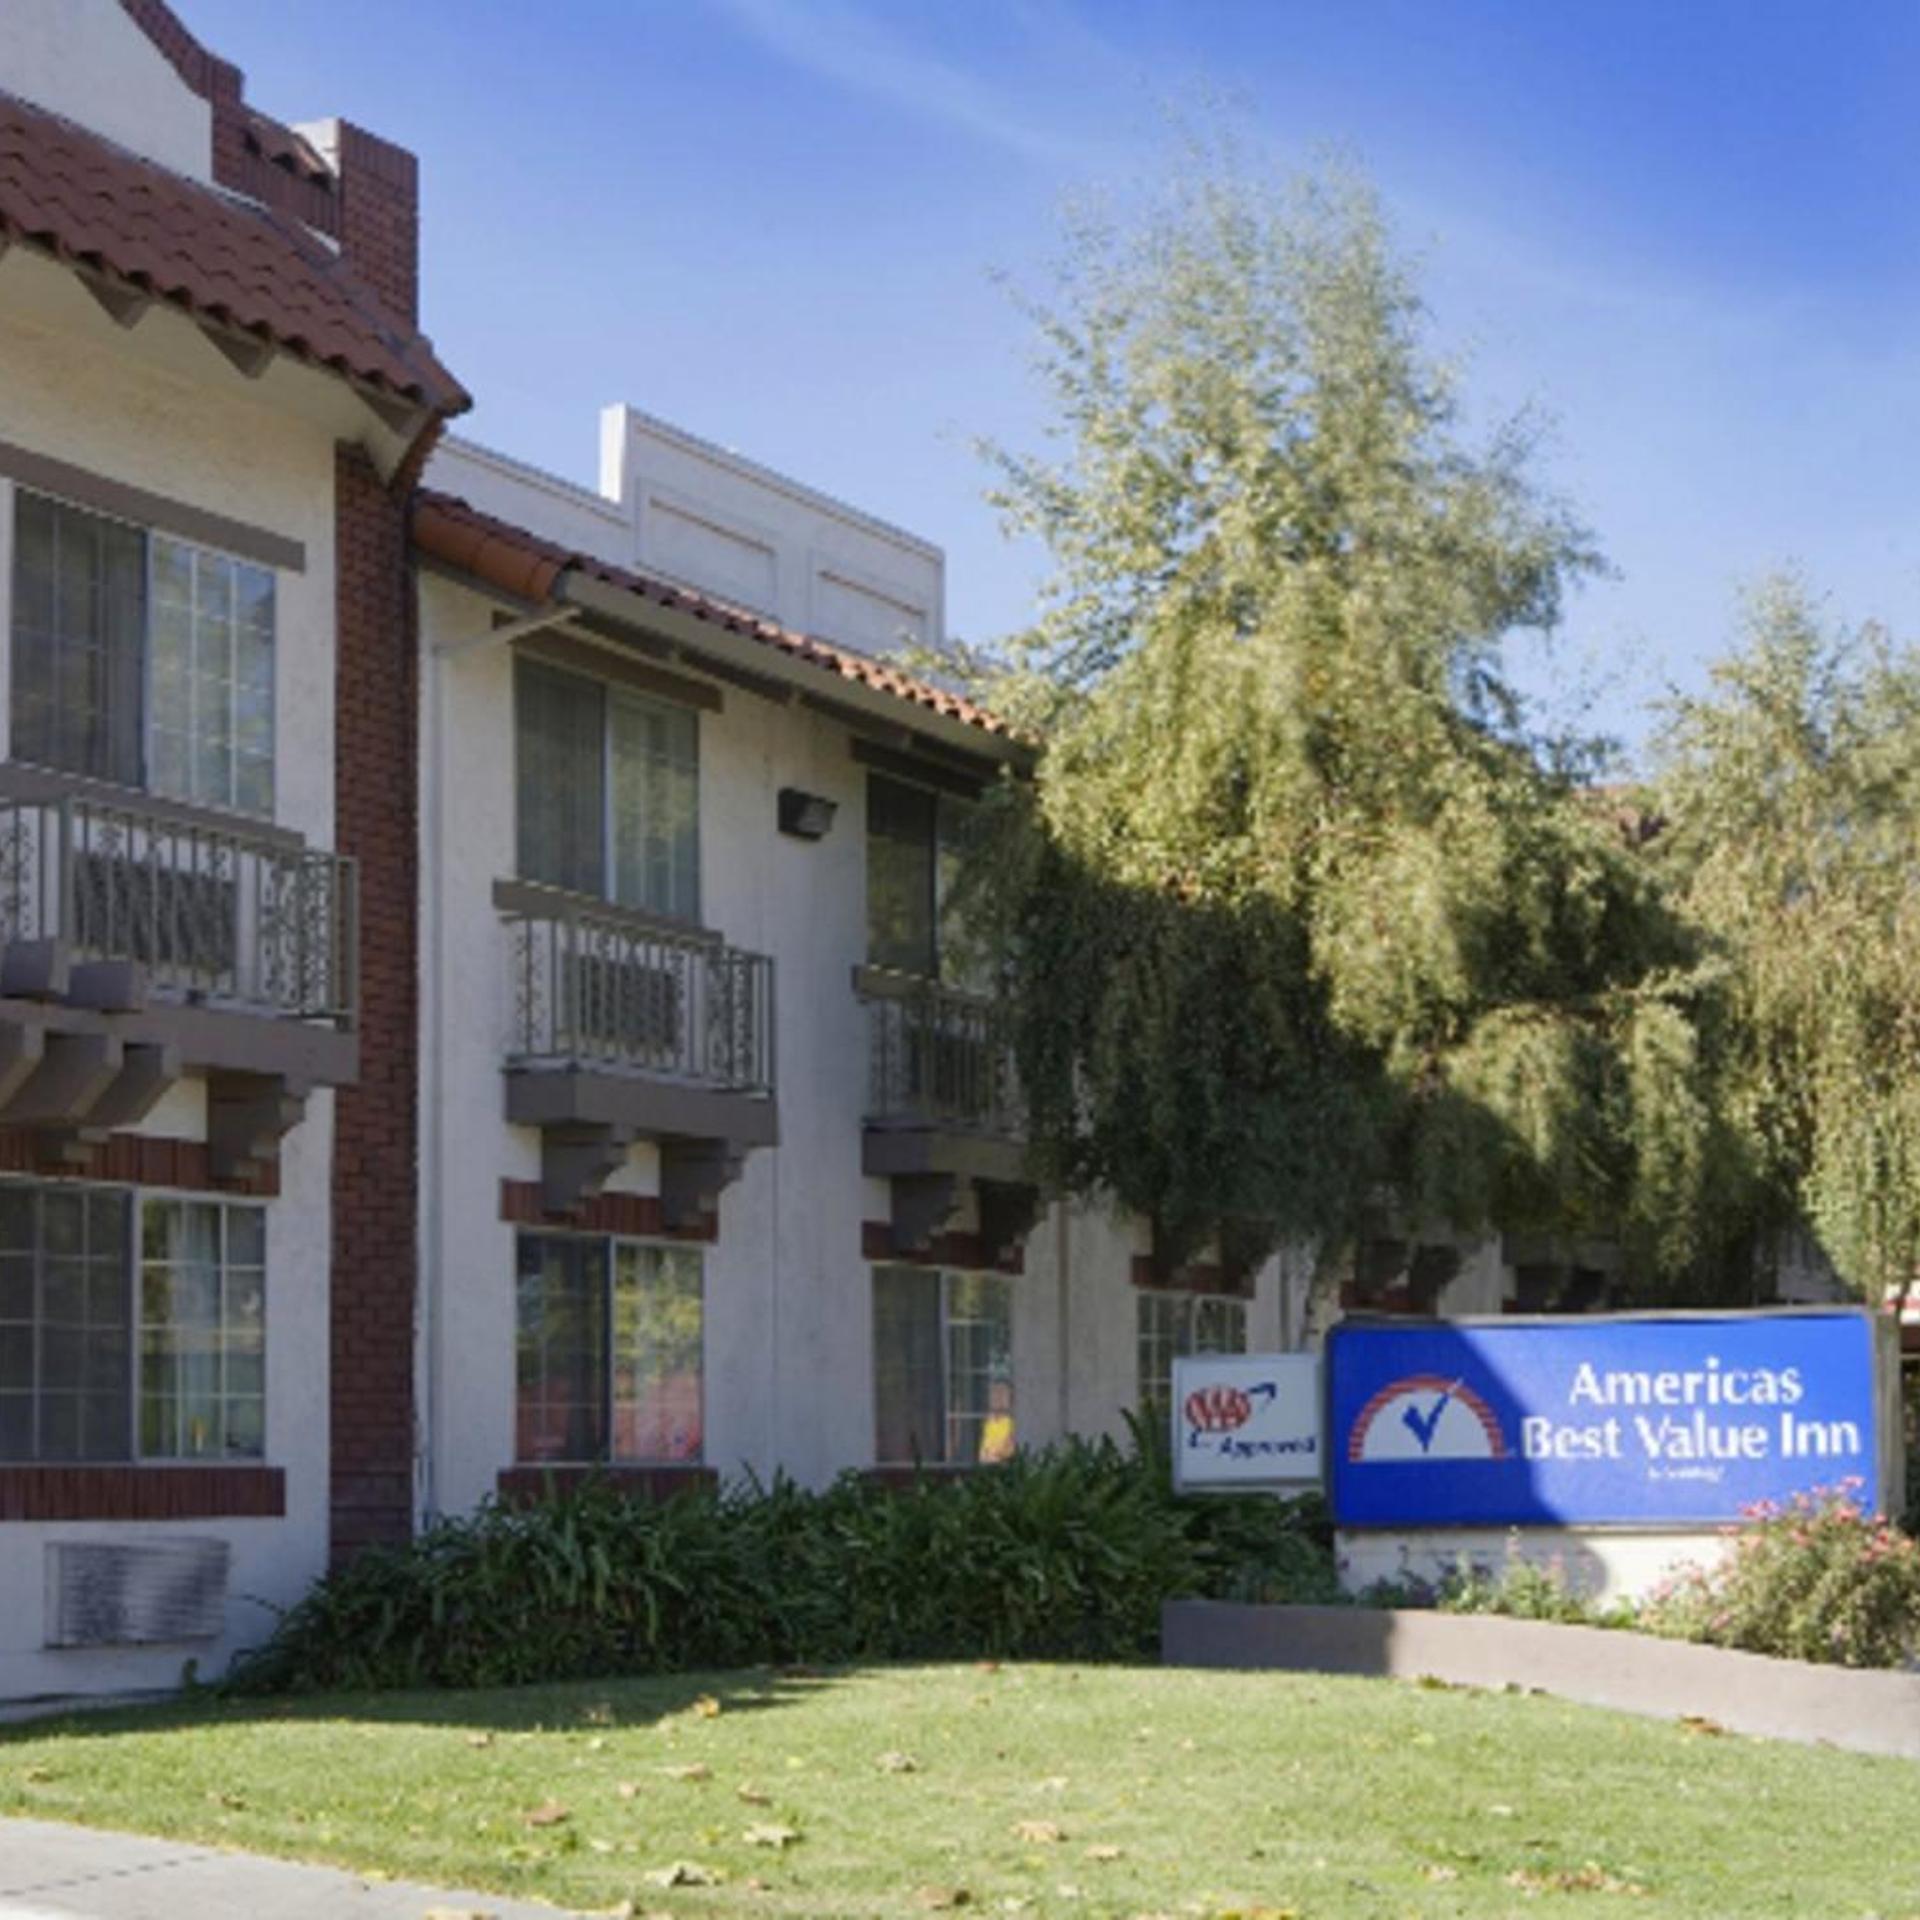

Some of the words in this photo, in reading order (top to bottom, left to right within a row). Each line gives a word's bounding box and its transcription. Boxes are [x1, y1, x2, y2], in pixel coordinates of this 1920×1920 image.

[1568, 1355, 1804, 1406] Americas
[1521, 1415, 1623, 1460] Best
[1634, 1409, 1769, 1460] Value
[1780, 1411, 1862, 1459] Inn
